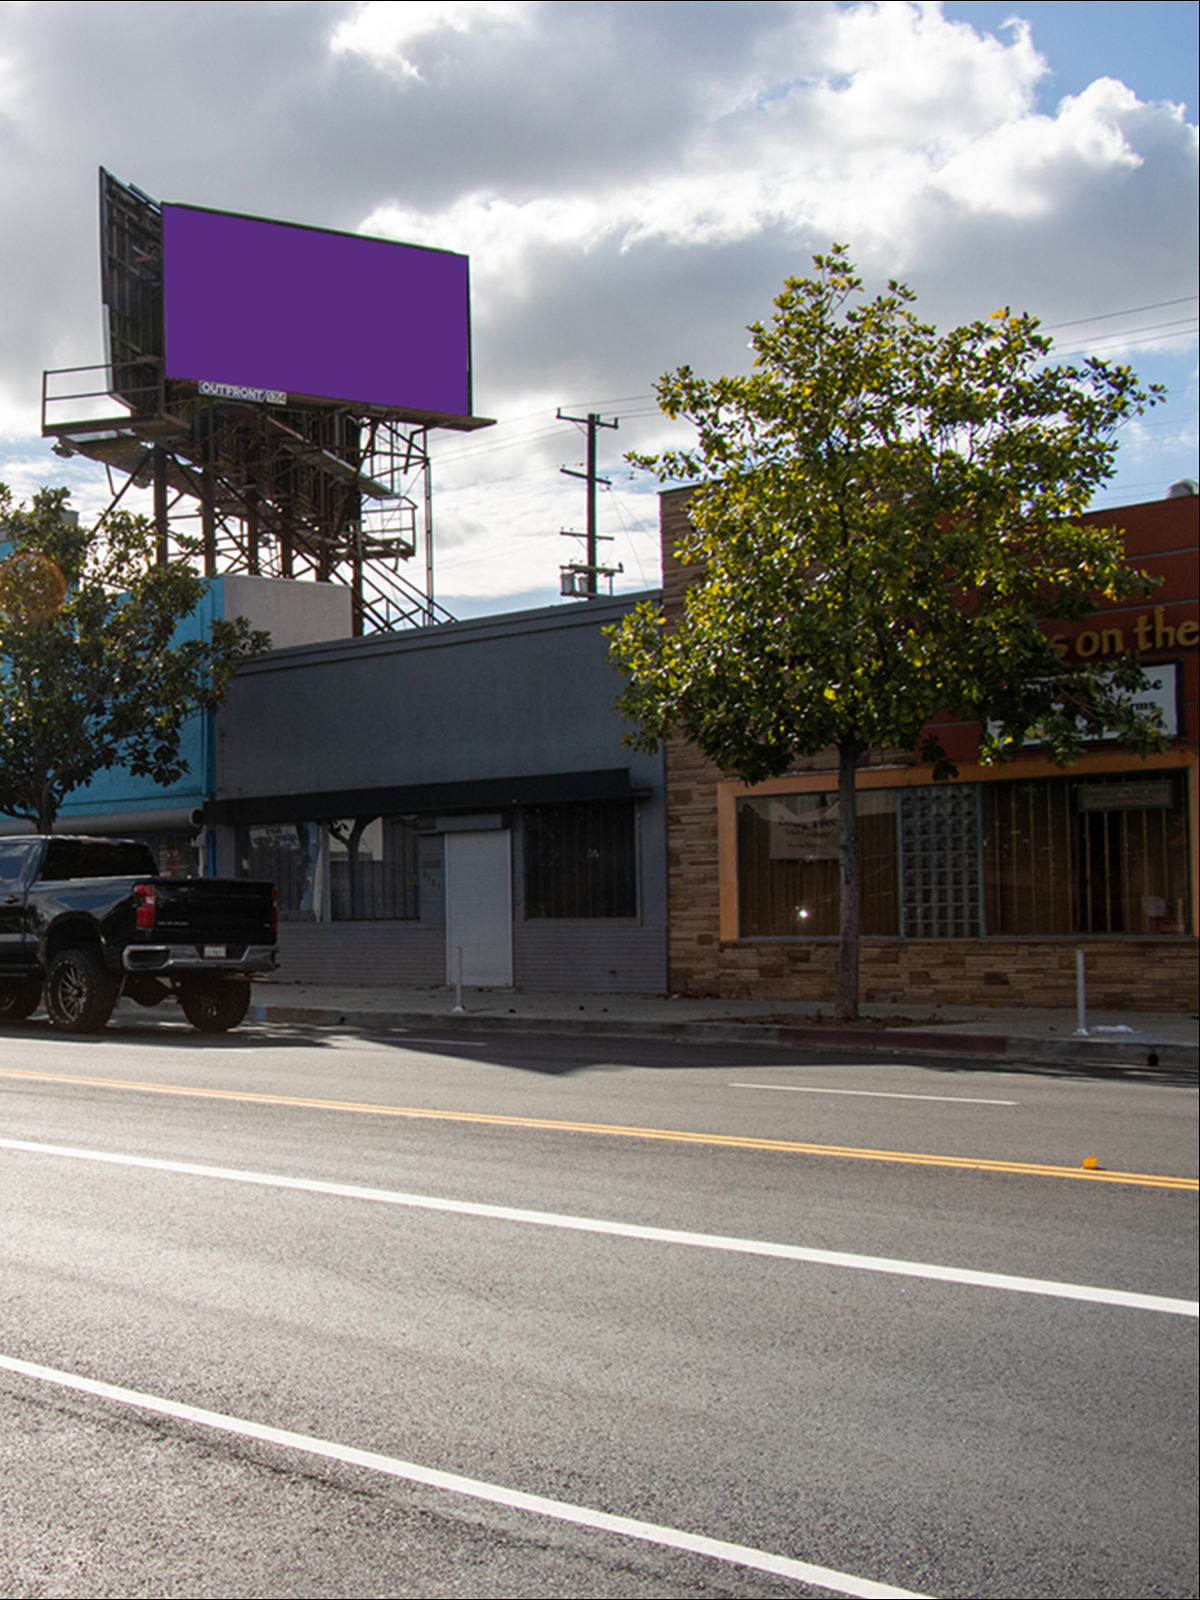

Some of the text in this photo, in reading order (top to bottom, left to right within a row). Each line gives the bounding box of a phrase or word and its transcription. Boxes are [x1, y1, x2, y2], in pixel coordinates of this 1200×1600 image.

[201, 381, 264, 400] OUTFRONT
[1075, 627, 1125, 657] on
[1133, 605, 1199, 651] the
